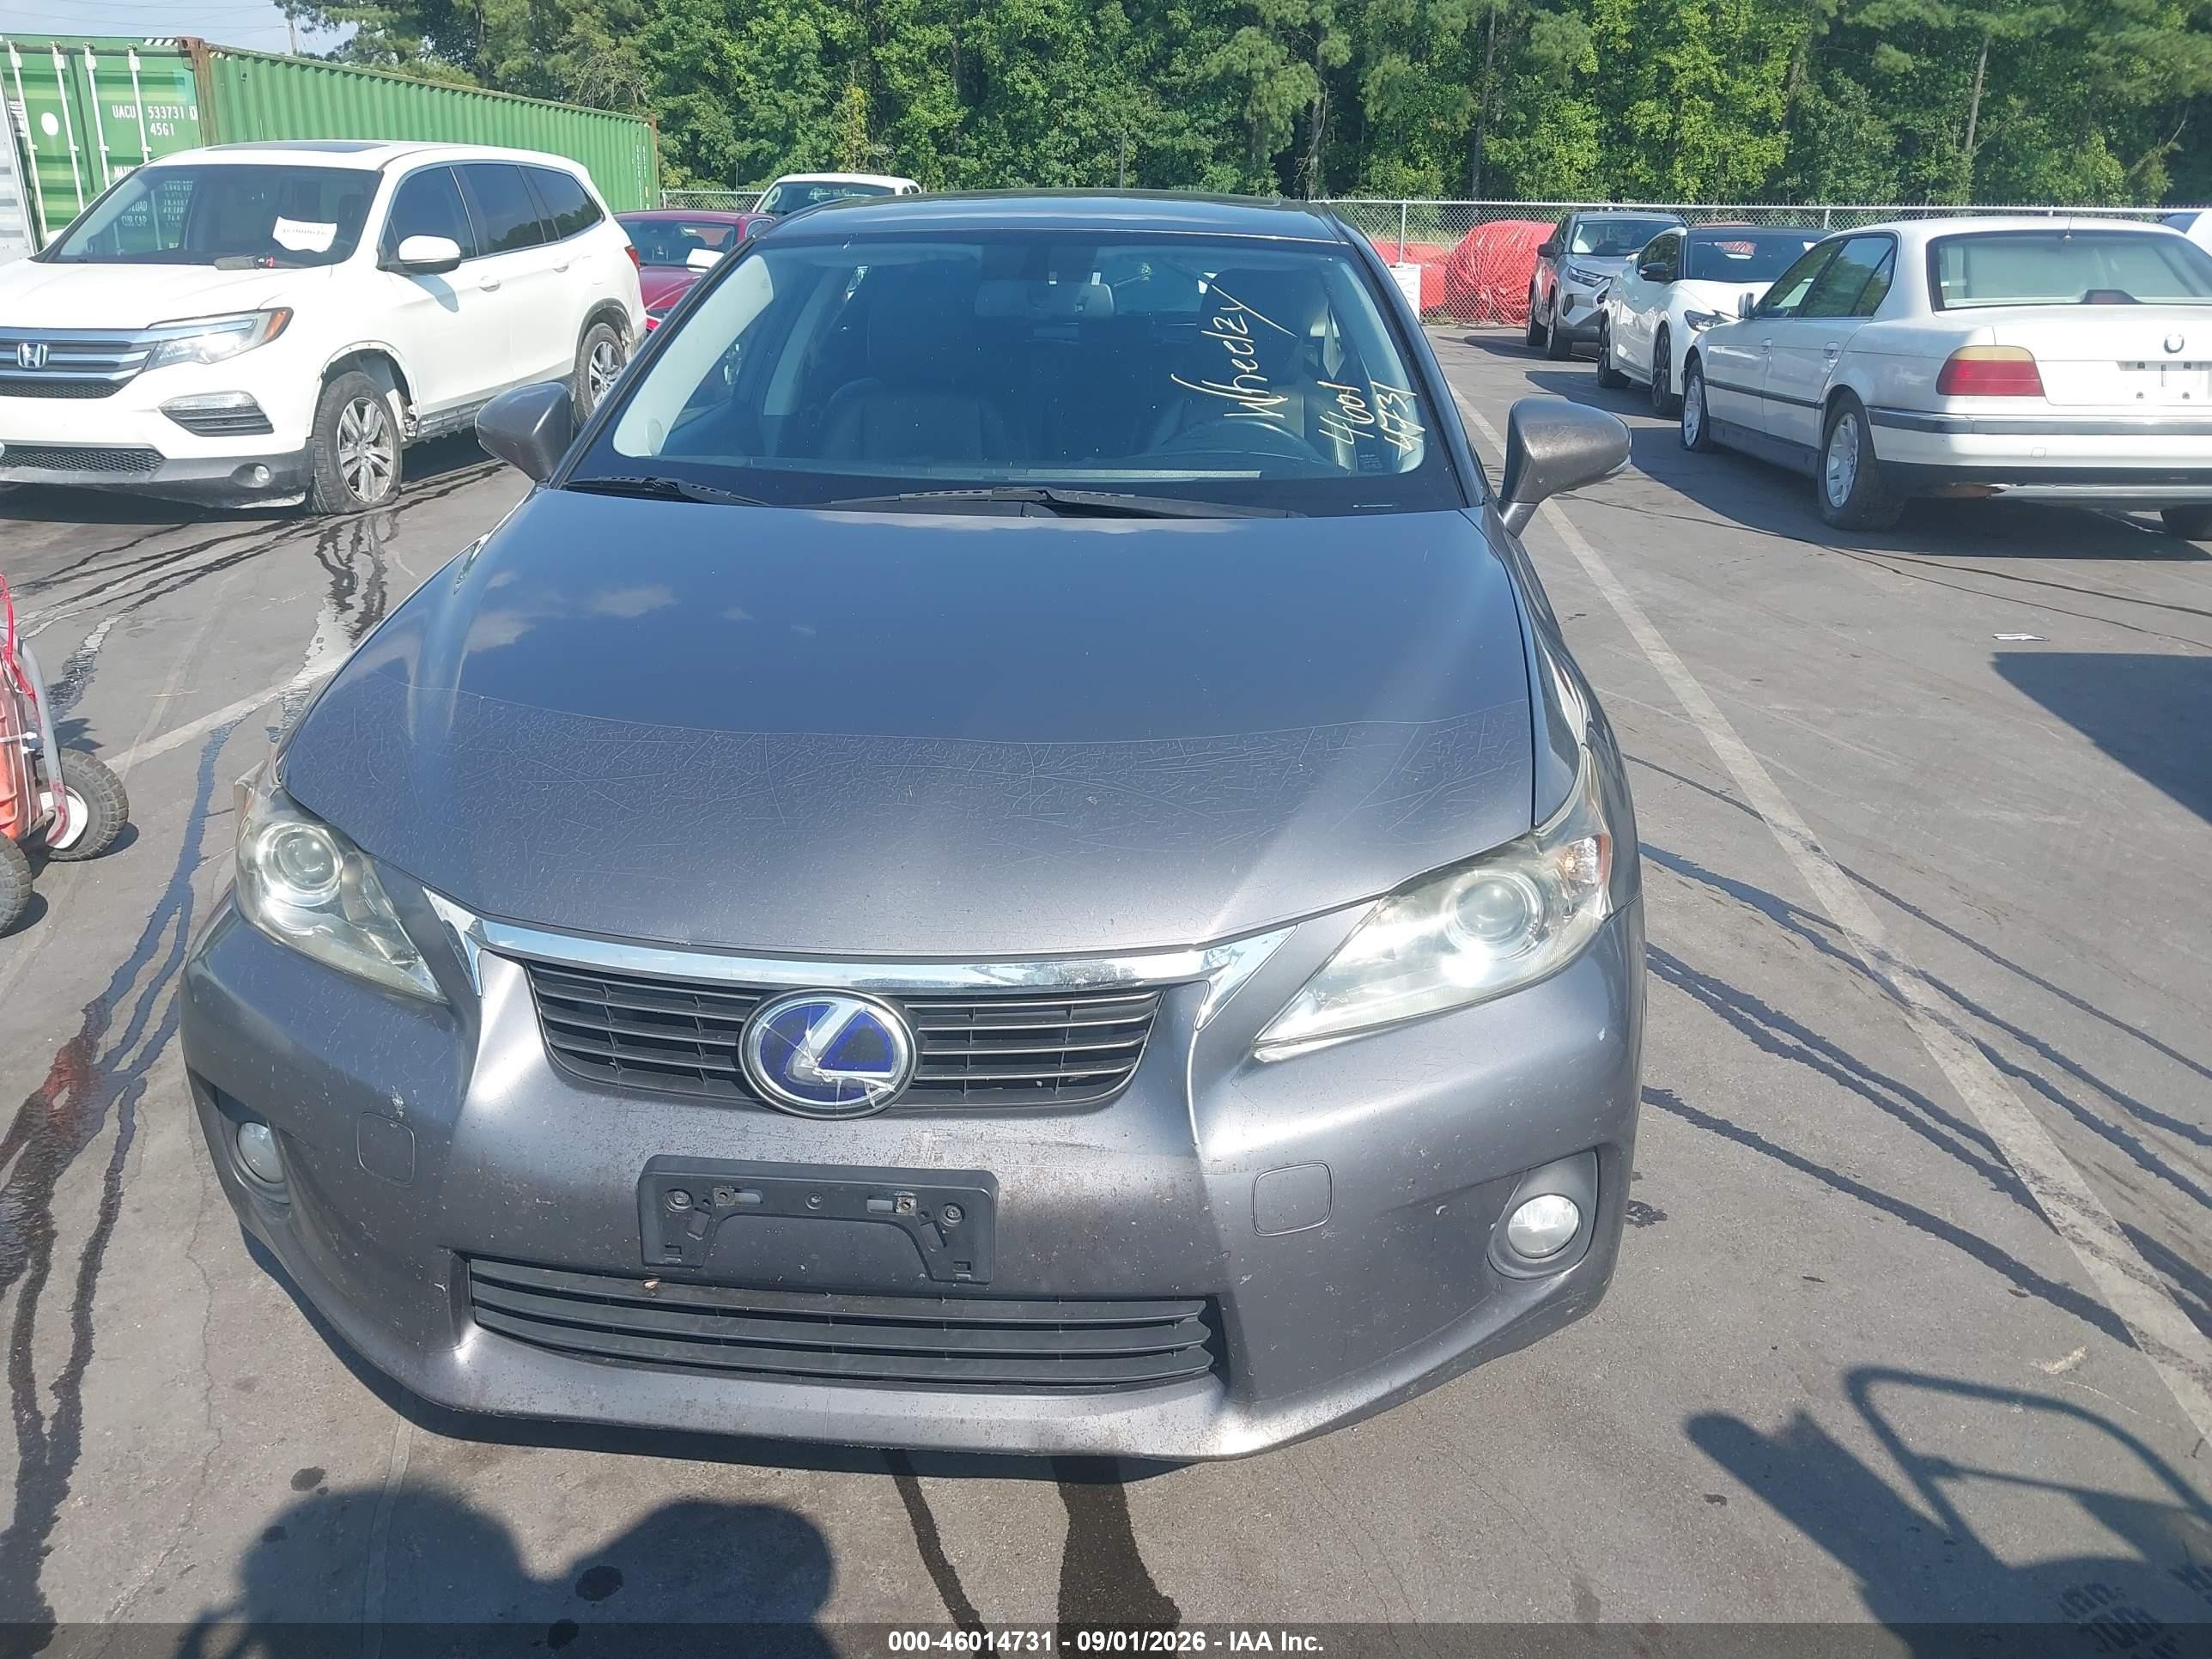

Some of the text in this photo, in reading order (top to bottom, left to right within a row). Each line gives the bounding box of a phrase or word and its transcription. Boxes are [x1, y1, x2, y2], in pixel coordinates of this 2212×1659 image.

[112, 105, 137, 118] UACU
[148, 105, 185, 119] 533731
[150, 123, 174, 136] 45G1
[1317, 380, 1375, 446] 4601
[1370, 380, 1425, 460] 4731
